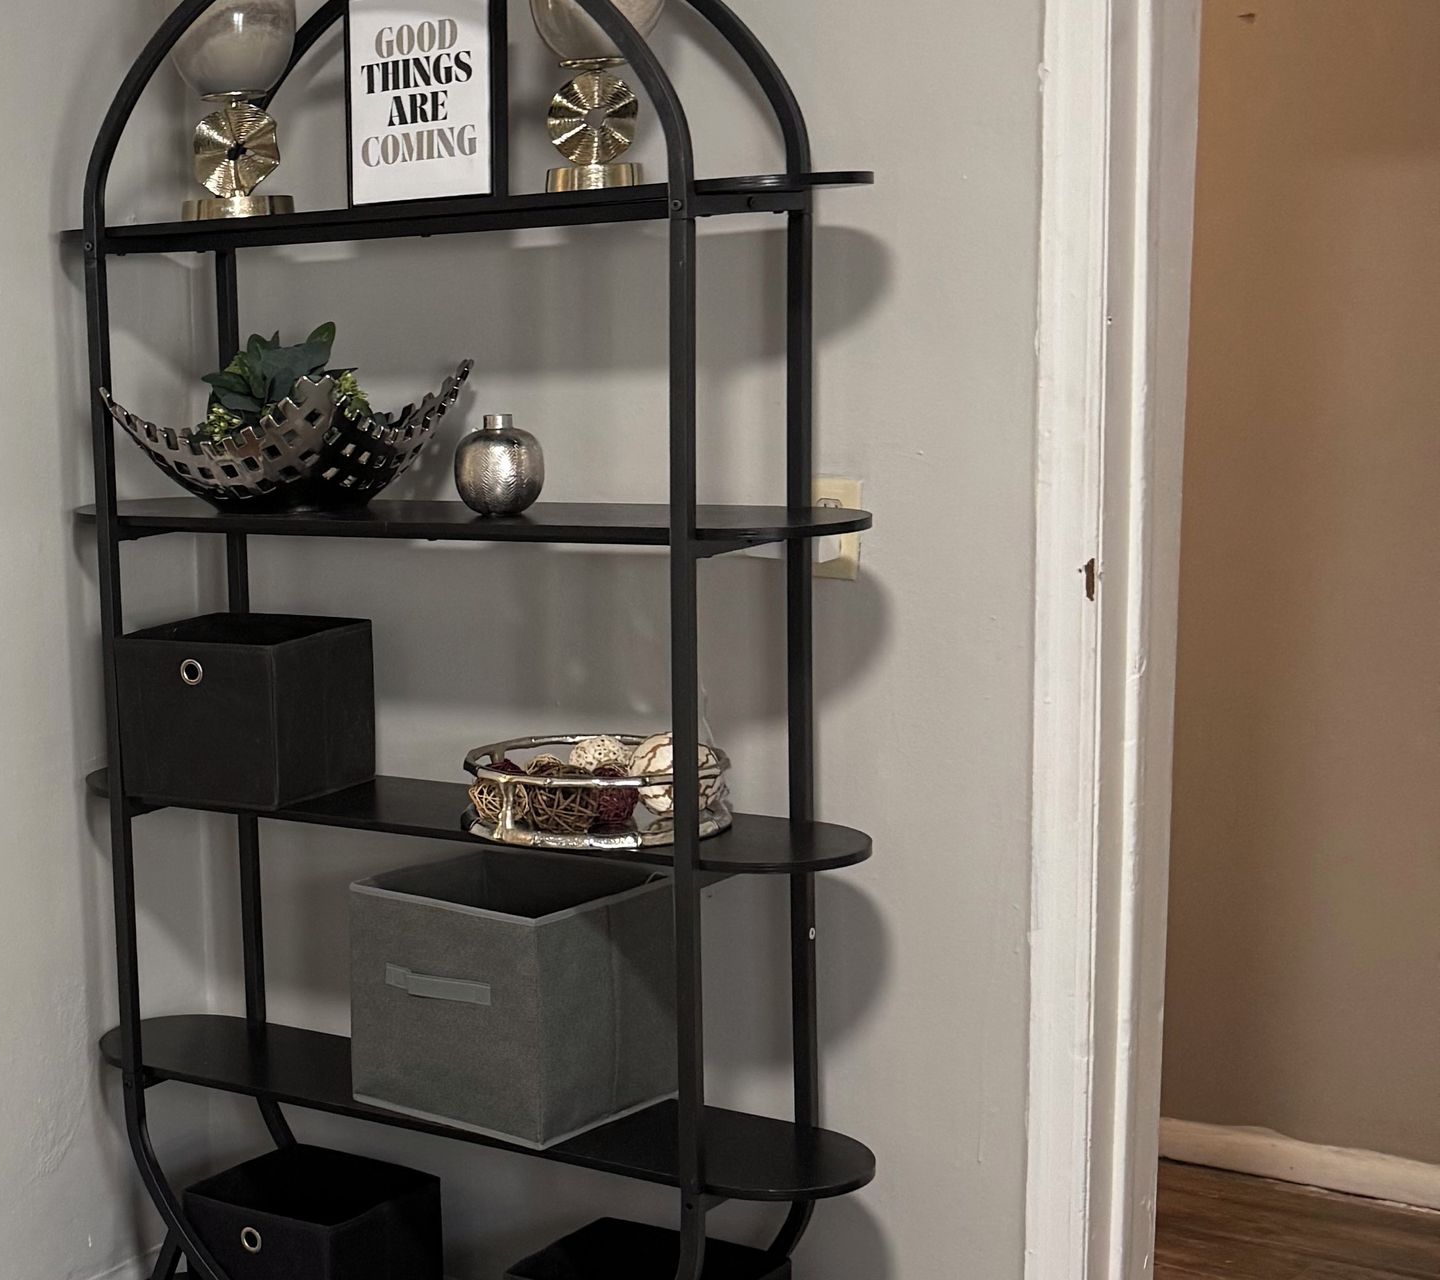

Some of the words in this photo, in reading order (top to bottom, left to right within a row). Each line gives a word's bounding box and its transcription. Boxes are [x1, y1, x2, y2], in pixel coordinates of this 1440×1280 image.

[374, 18, 458, 59] GOOD
[361, 50, 473, 95] THINGS
[387, 90, 448, 127] ARE
[361, 124, 478, 168] COMING
